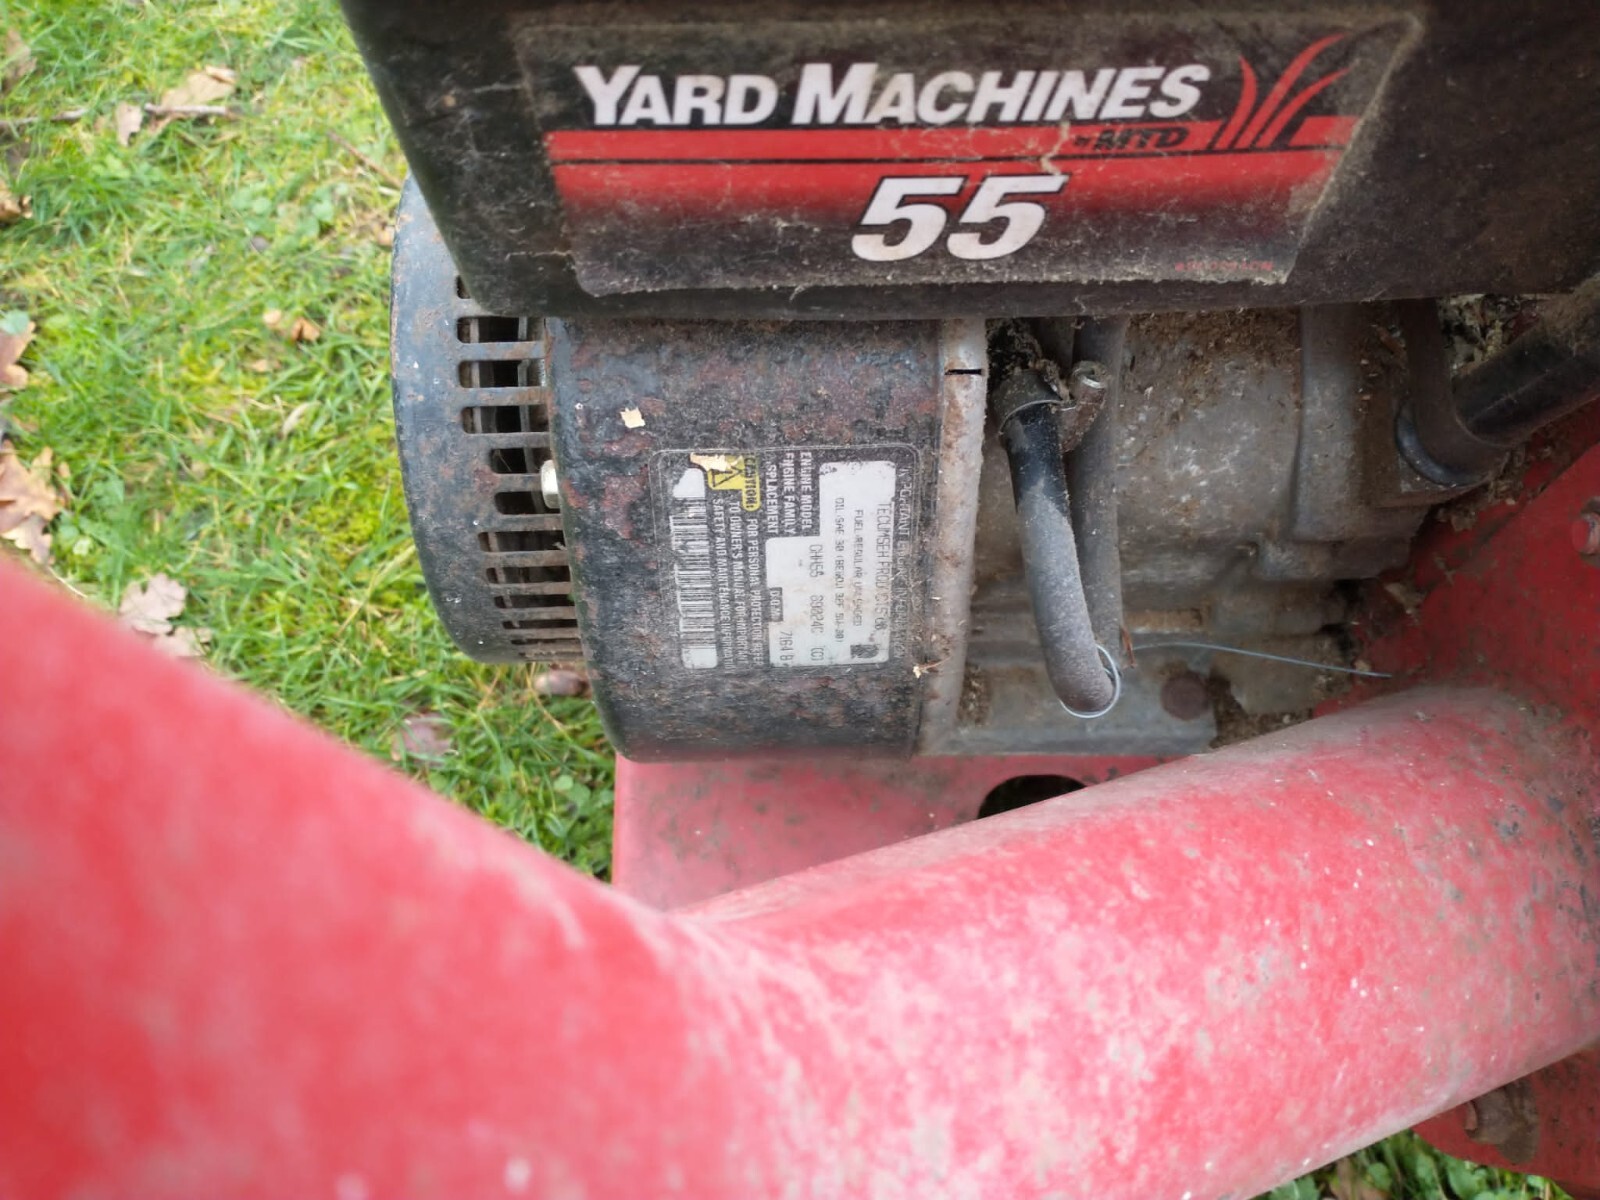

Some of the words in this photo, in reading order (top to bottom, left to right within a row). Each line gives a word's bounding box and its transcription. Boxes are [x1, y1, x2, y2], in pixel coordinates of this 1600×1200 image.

[574, 65, 777, 127] YARD
[797, 62, 1211, 126] MACHINES
[850, 173, 1070, 262] 55
[800, 452, 812, 491] ENGINE
[713, 499, 725, 533] SAFETY
[729, 501, 740, 513] TO
[766, 460, 779, 534] SPLACEMENT
[782, 495, 796, 534] FAMILY
[801, 495, 812, 530] MODEL
[715, 537, 726, 556] AND
[730, 516, 743, 559] OWNER'S
[746, 518, 759, 537] FOR
[877, 502, 892, 557] TECUMSEH
[733, 561, 746, 599] MANUAL
[747, 540, 760, 586] PERSONAL
[716, 558, 731, 621] MAINTENANCE
[750, 590, 762, 640] PROTECTION
